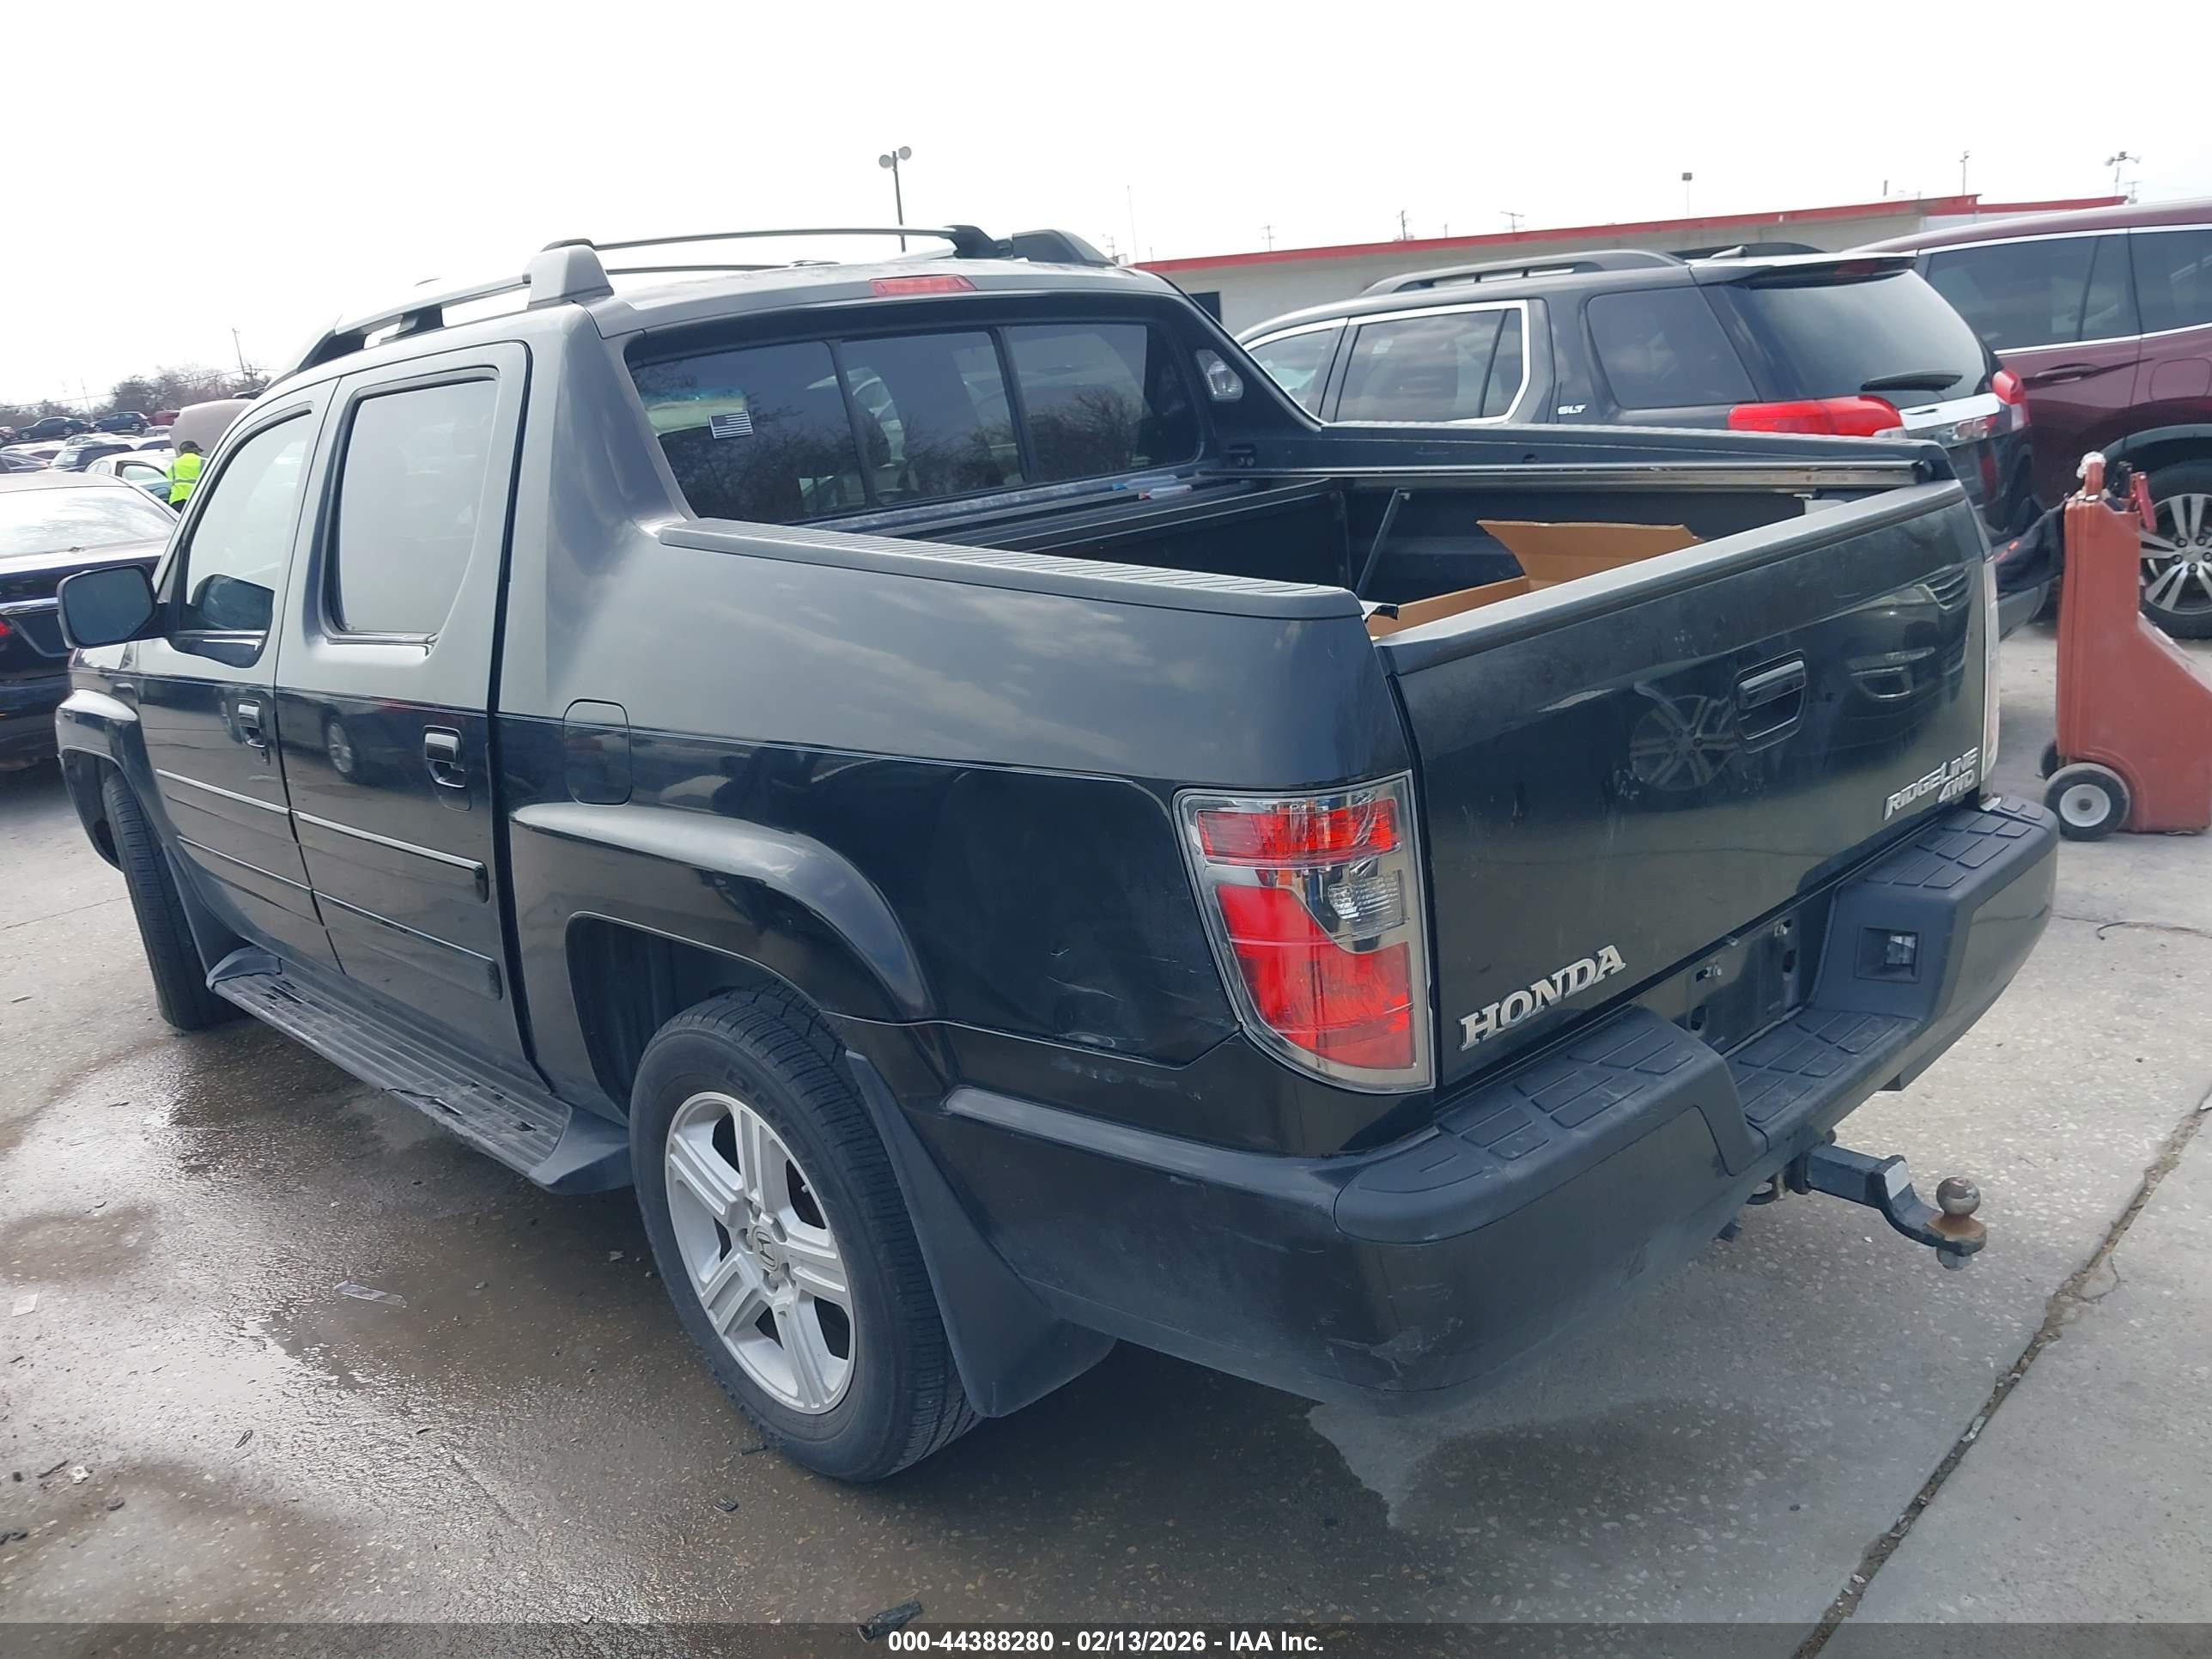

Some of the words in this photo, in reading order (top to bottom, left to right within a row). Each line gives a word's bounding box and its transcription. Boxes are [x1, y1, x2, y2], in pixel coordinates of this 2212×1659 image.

[1558, 404, 1588, 415] SLT
[1883, 746, 1978, 821] RIDGELINE
[1937, 769, 1975, 804] 4WD
[1459, 945, 1627, 1052] HONDA
